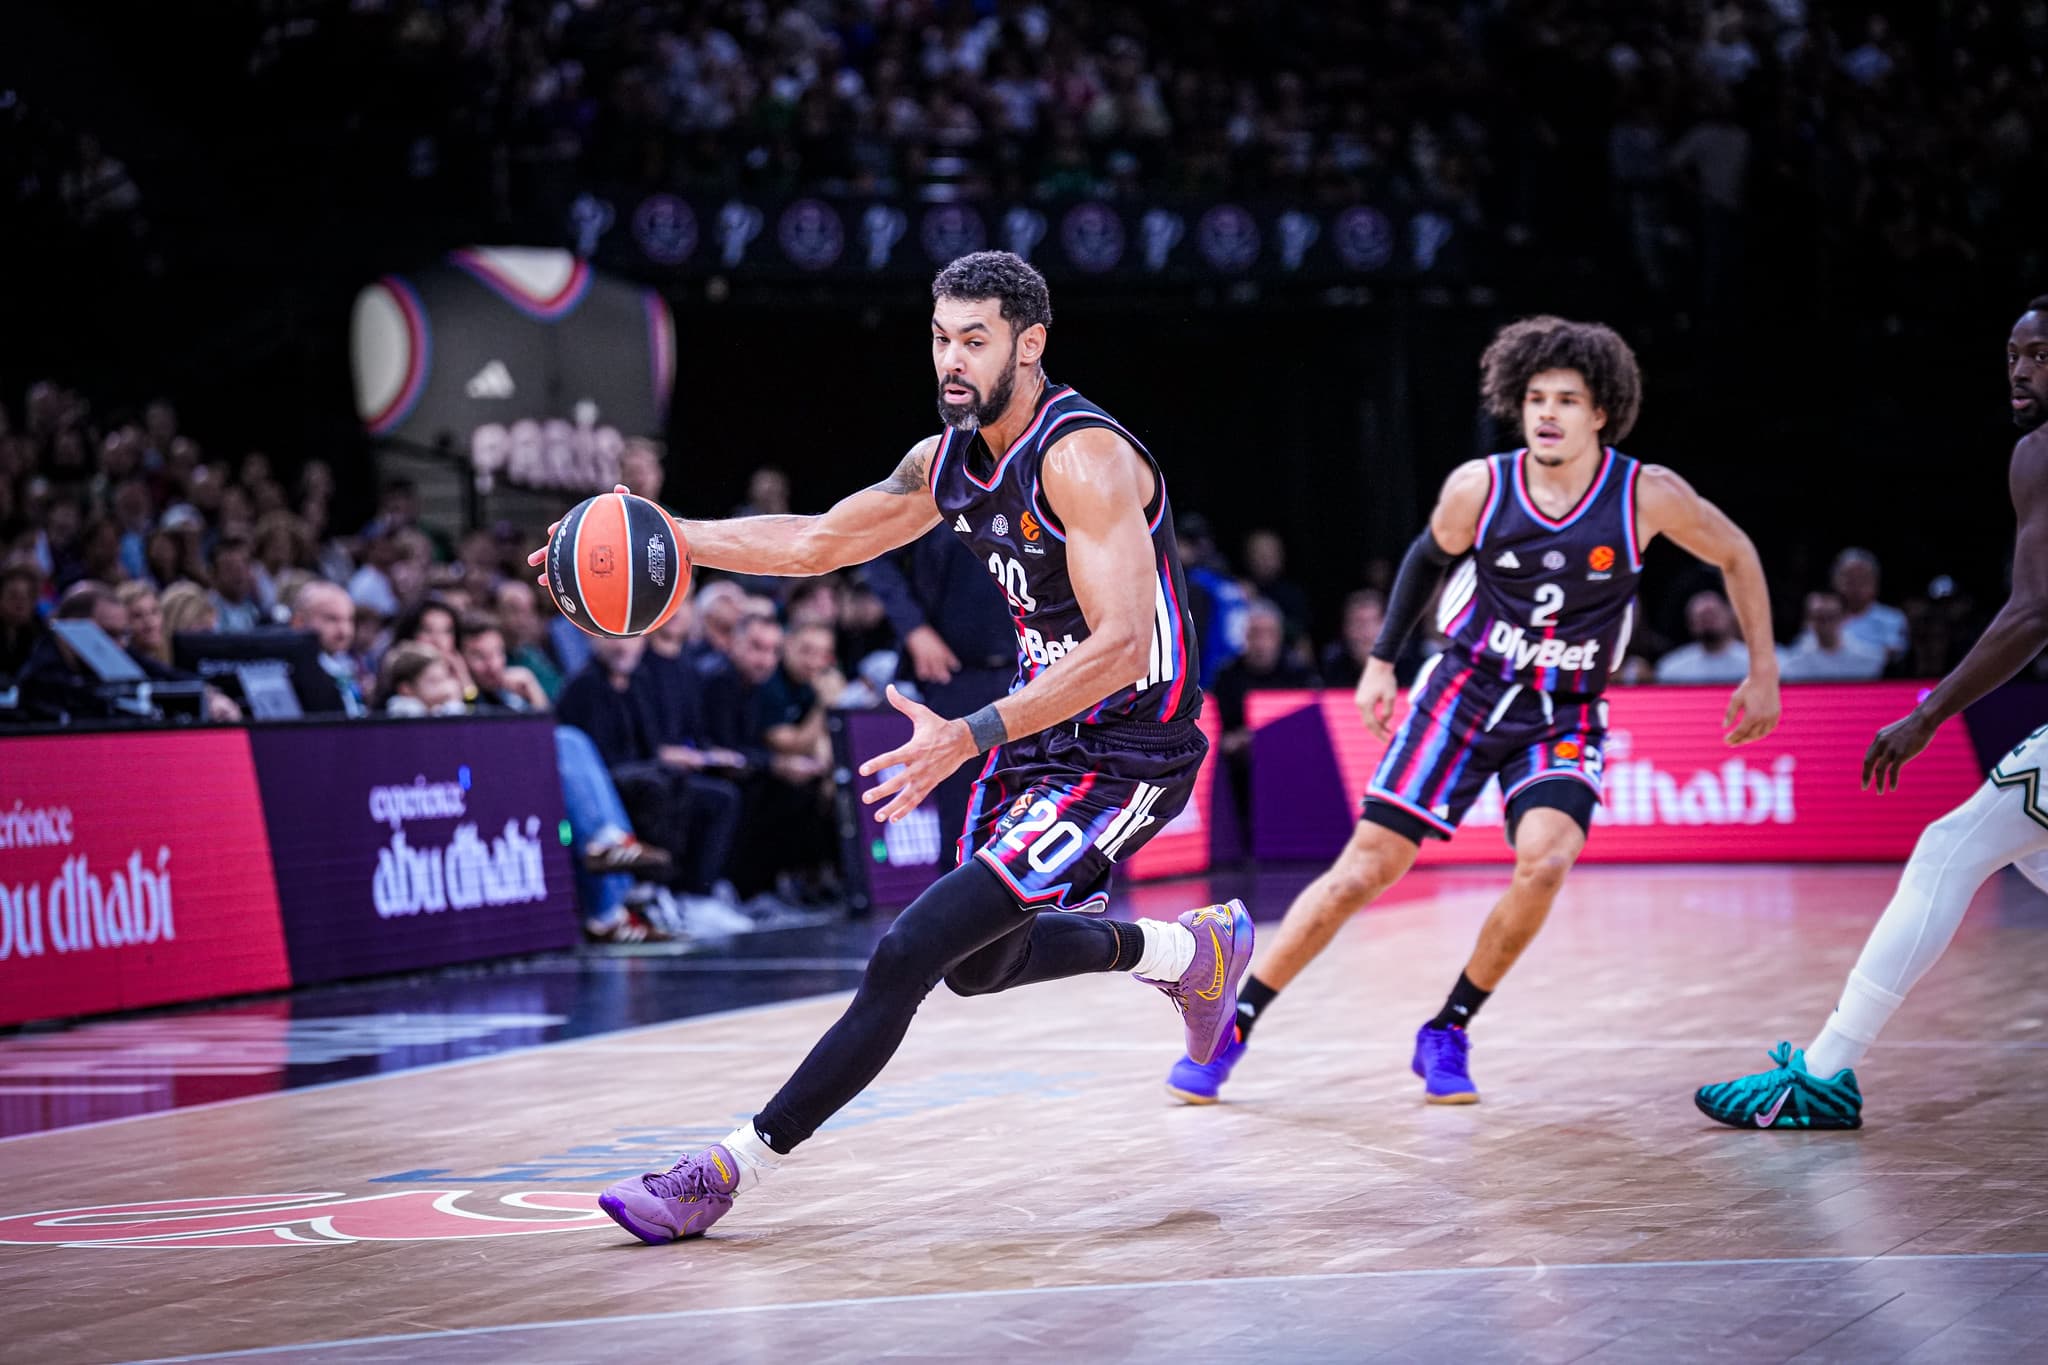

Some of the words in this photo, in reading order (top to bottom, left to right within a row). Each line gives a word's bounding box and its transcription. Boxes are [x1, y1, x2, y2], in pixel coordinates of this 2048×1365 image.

[1532, 583, 1565, 627] 2
[1489, 620, 1600, 671] OlyBet
[373, 829, 447, 918] abu
[445, 815, 547, 911] dhabi
[1001, 799, 1083, 873] 20
[48, 845, 175, 955] dhabi
